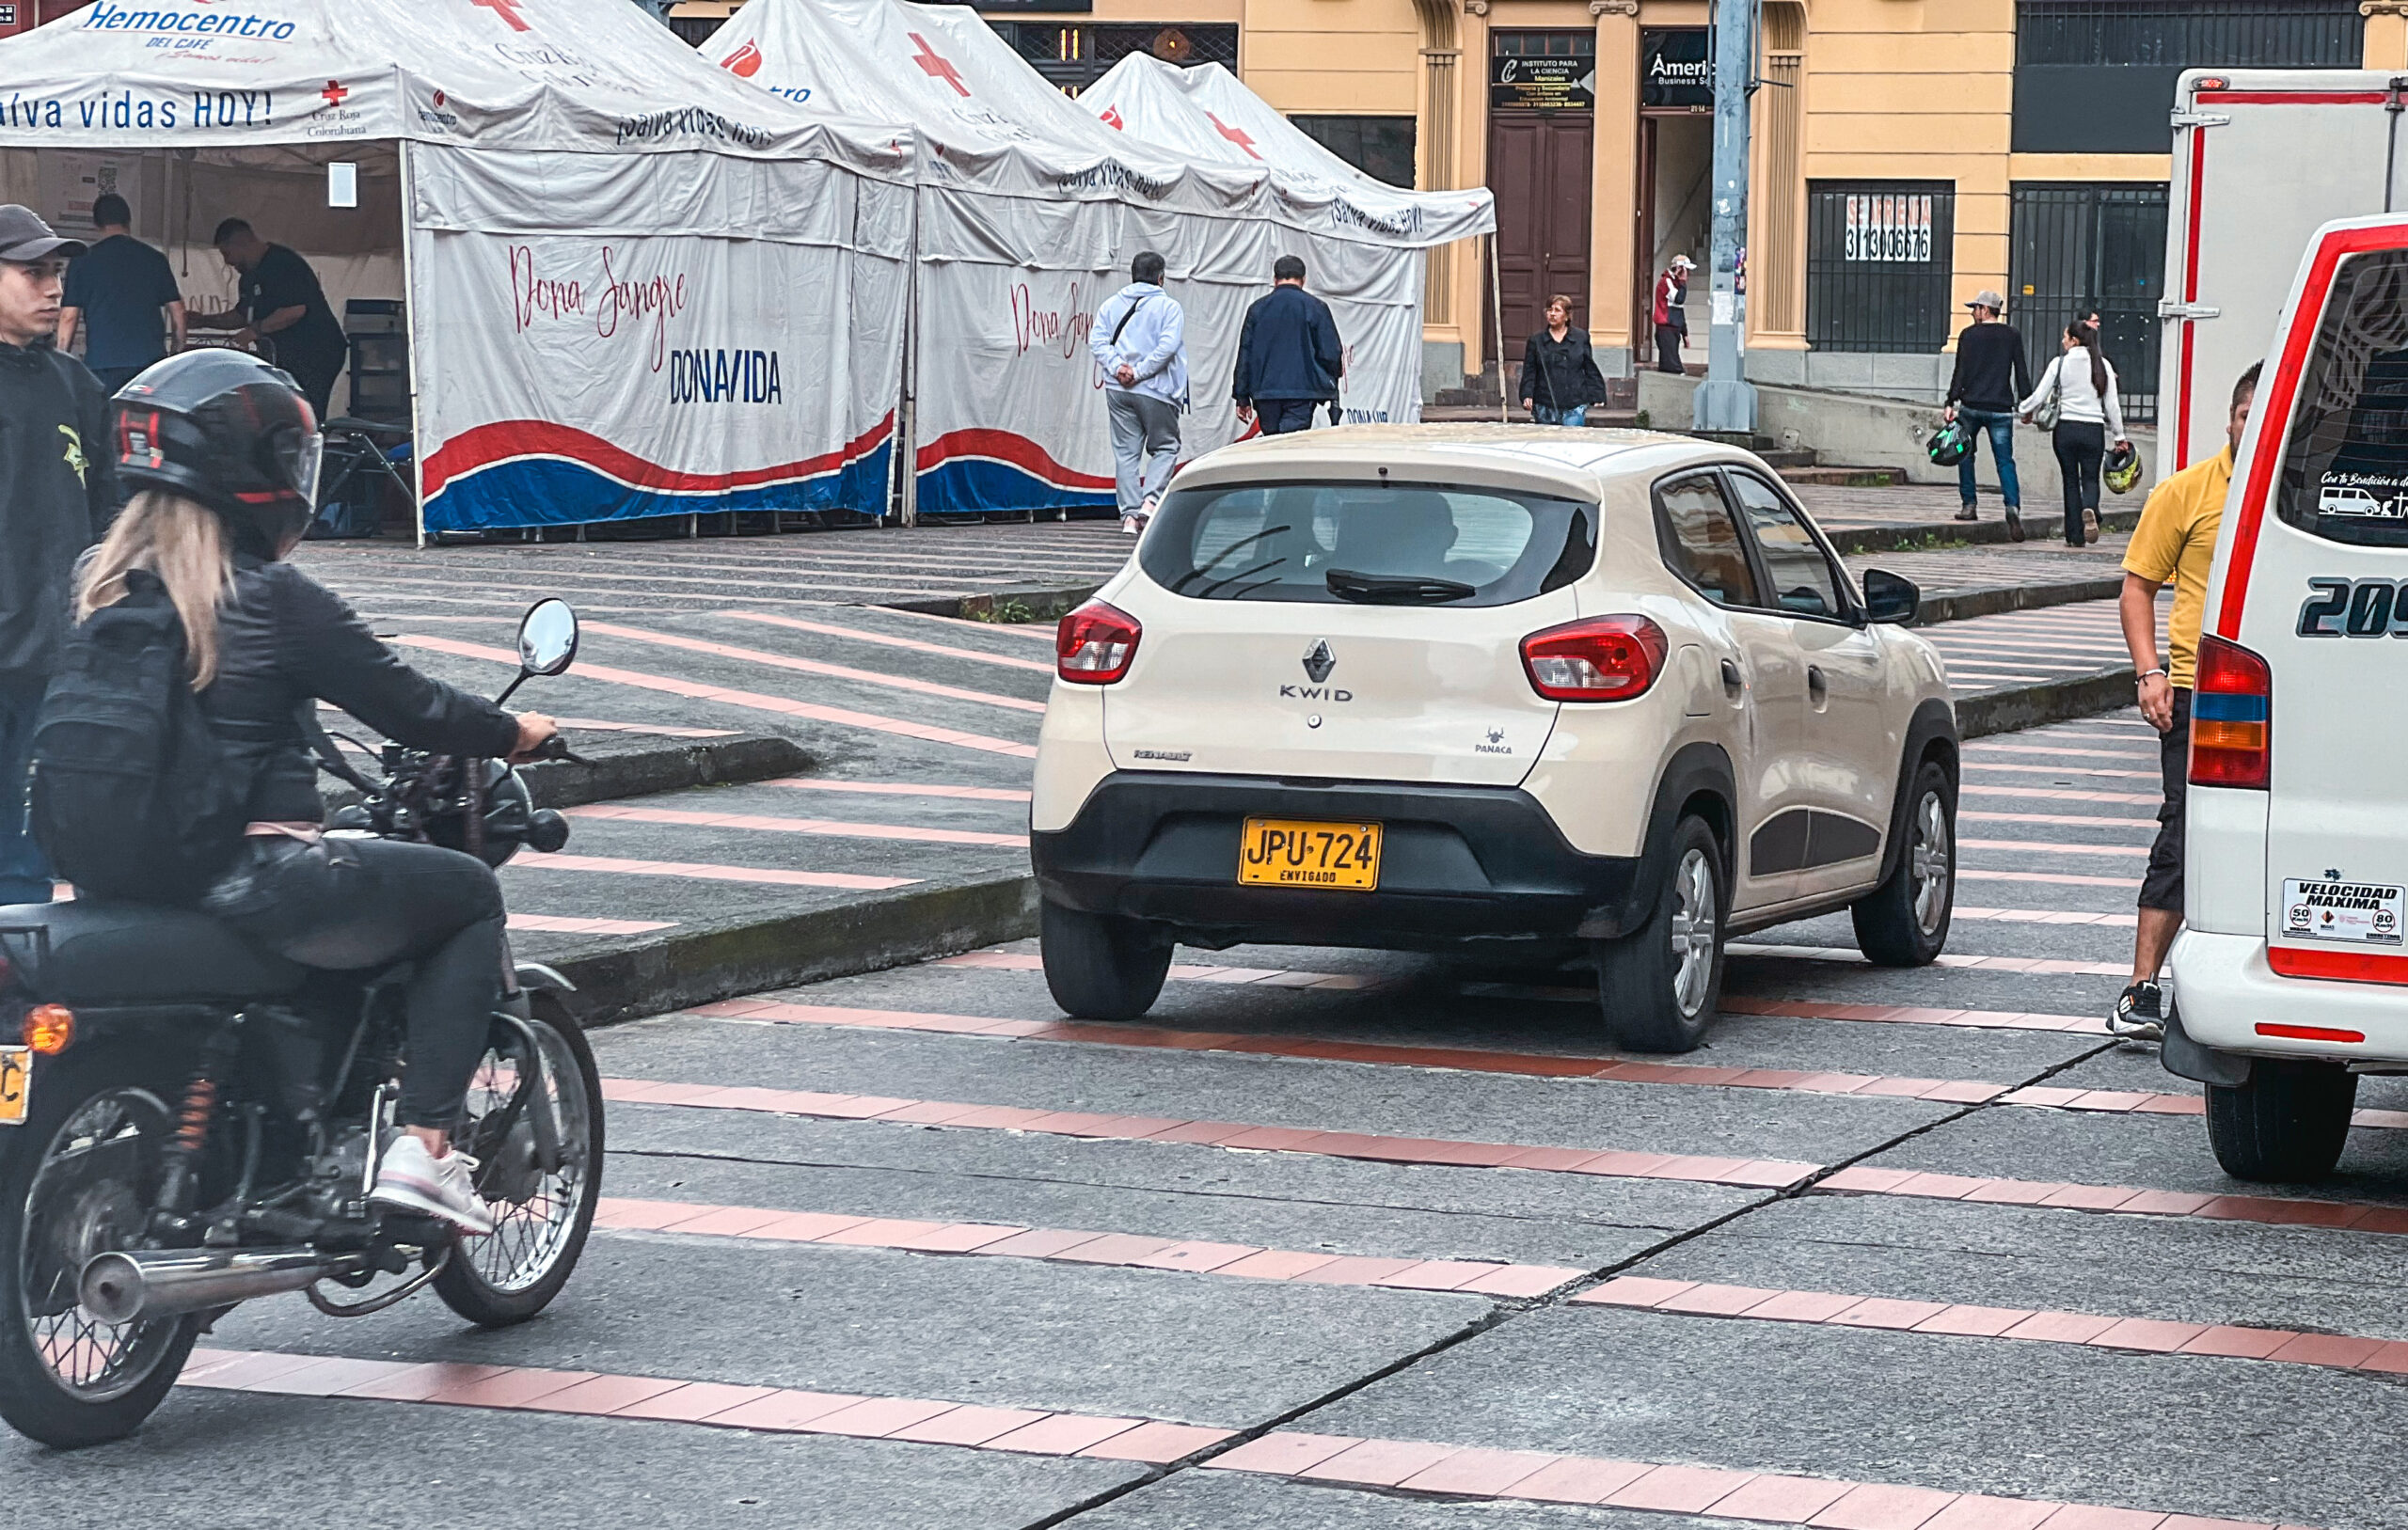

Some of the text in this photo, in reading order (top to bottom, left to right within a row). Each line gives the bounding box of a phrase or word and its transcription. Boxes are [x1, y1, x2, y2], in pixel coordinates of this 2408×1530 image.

[83, 1, 295, 39] Hemocentro
[146, 37, 214, 51] DEL CAFÉ
[79, 90, 177, 128] vidas
[194, 91, 272, 128] HOY!
[312, 110, 361, 121] Cruz Roja
[307, 124, 367, 137] Colombiana
[509, 244, 689, 372] Dona Sangre
[1010, 283, 1060, 357] Dona
[2321, 471, 2337, 483] Con
[1280, 685, 1353, 702] KWID
[1133, 749, 1193, 762] RENAULT
[1475, 744, 1513, 754] PANACA
[1280, 870, 1336, 883] ENVIGADO
[2299, 882, 2398, 899] VELOCIDAD
[2306, 895, 2381, 910] MAXIMA
[2292, 908, 2309, 917] 50
[2376, 914, 2393, 923] 80
